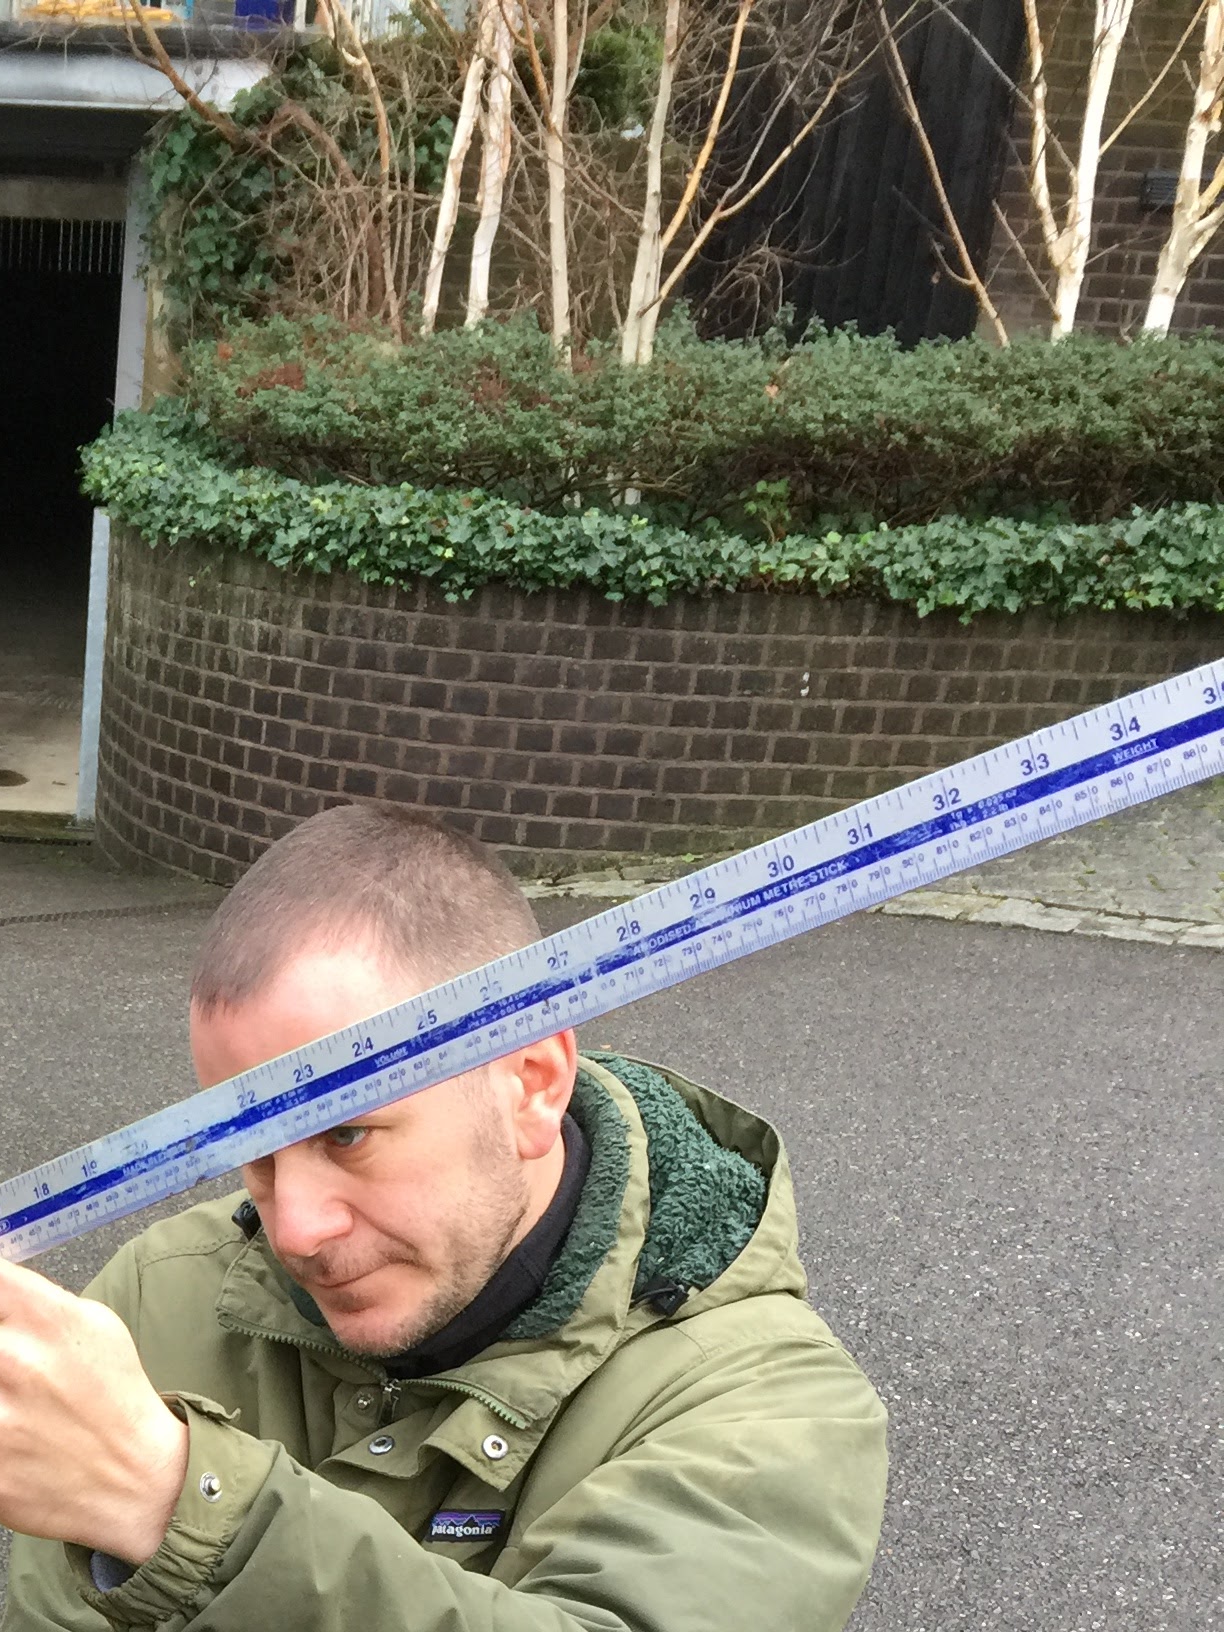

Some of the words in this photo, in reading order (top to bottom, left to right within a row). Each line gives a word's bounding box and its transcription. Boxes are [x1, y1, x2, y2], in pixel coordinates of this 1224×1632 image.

[1112, 738, 1160, 765] WEIGHT
[33, 1182, 50, 1199] 18
[81, 1159, 98, 1178] 19
[236, 1089, 257, 1109] 22
[293, 1064, 314, 1083] 23
[352, 1036, 374, 1058] 24
[547, 950, 569, 970] 27
[616, 919, 641, 943] 28
[689, 887, 716, 911] 29
[767, 854, 795, 879] 30
[847, 822, 874, 845] 31
[932, 787, 962, 811] 32
[1020, 752, 1051, 777] 33
[1109, 716, 1142, 742] 34
[1202, 683, 1224, 706] 3
[431, 1523, 495, 1538] patagonia
